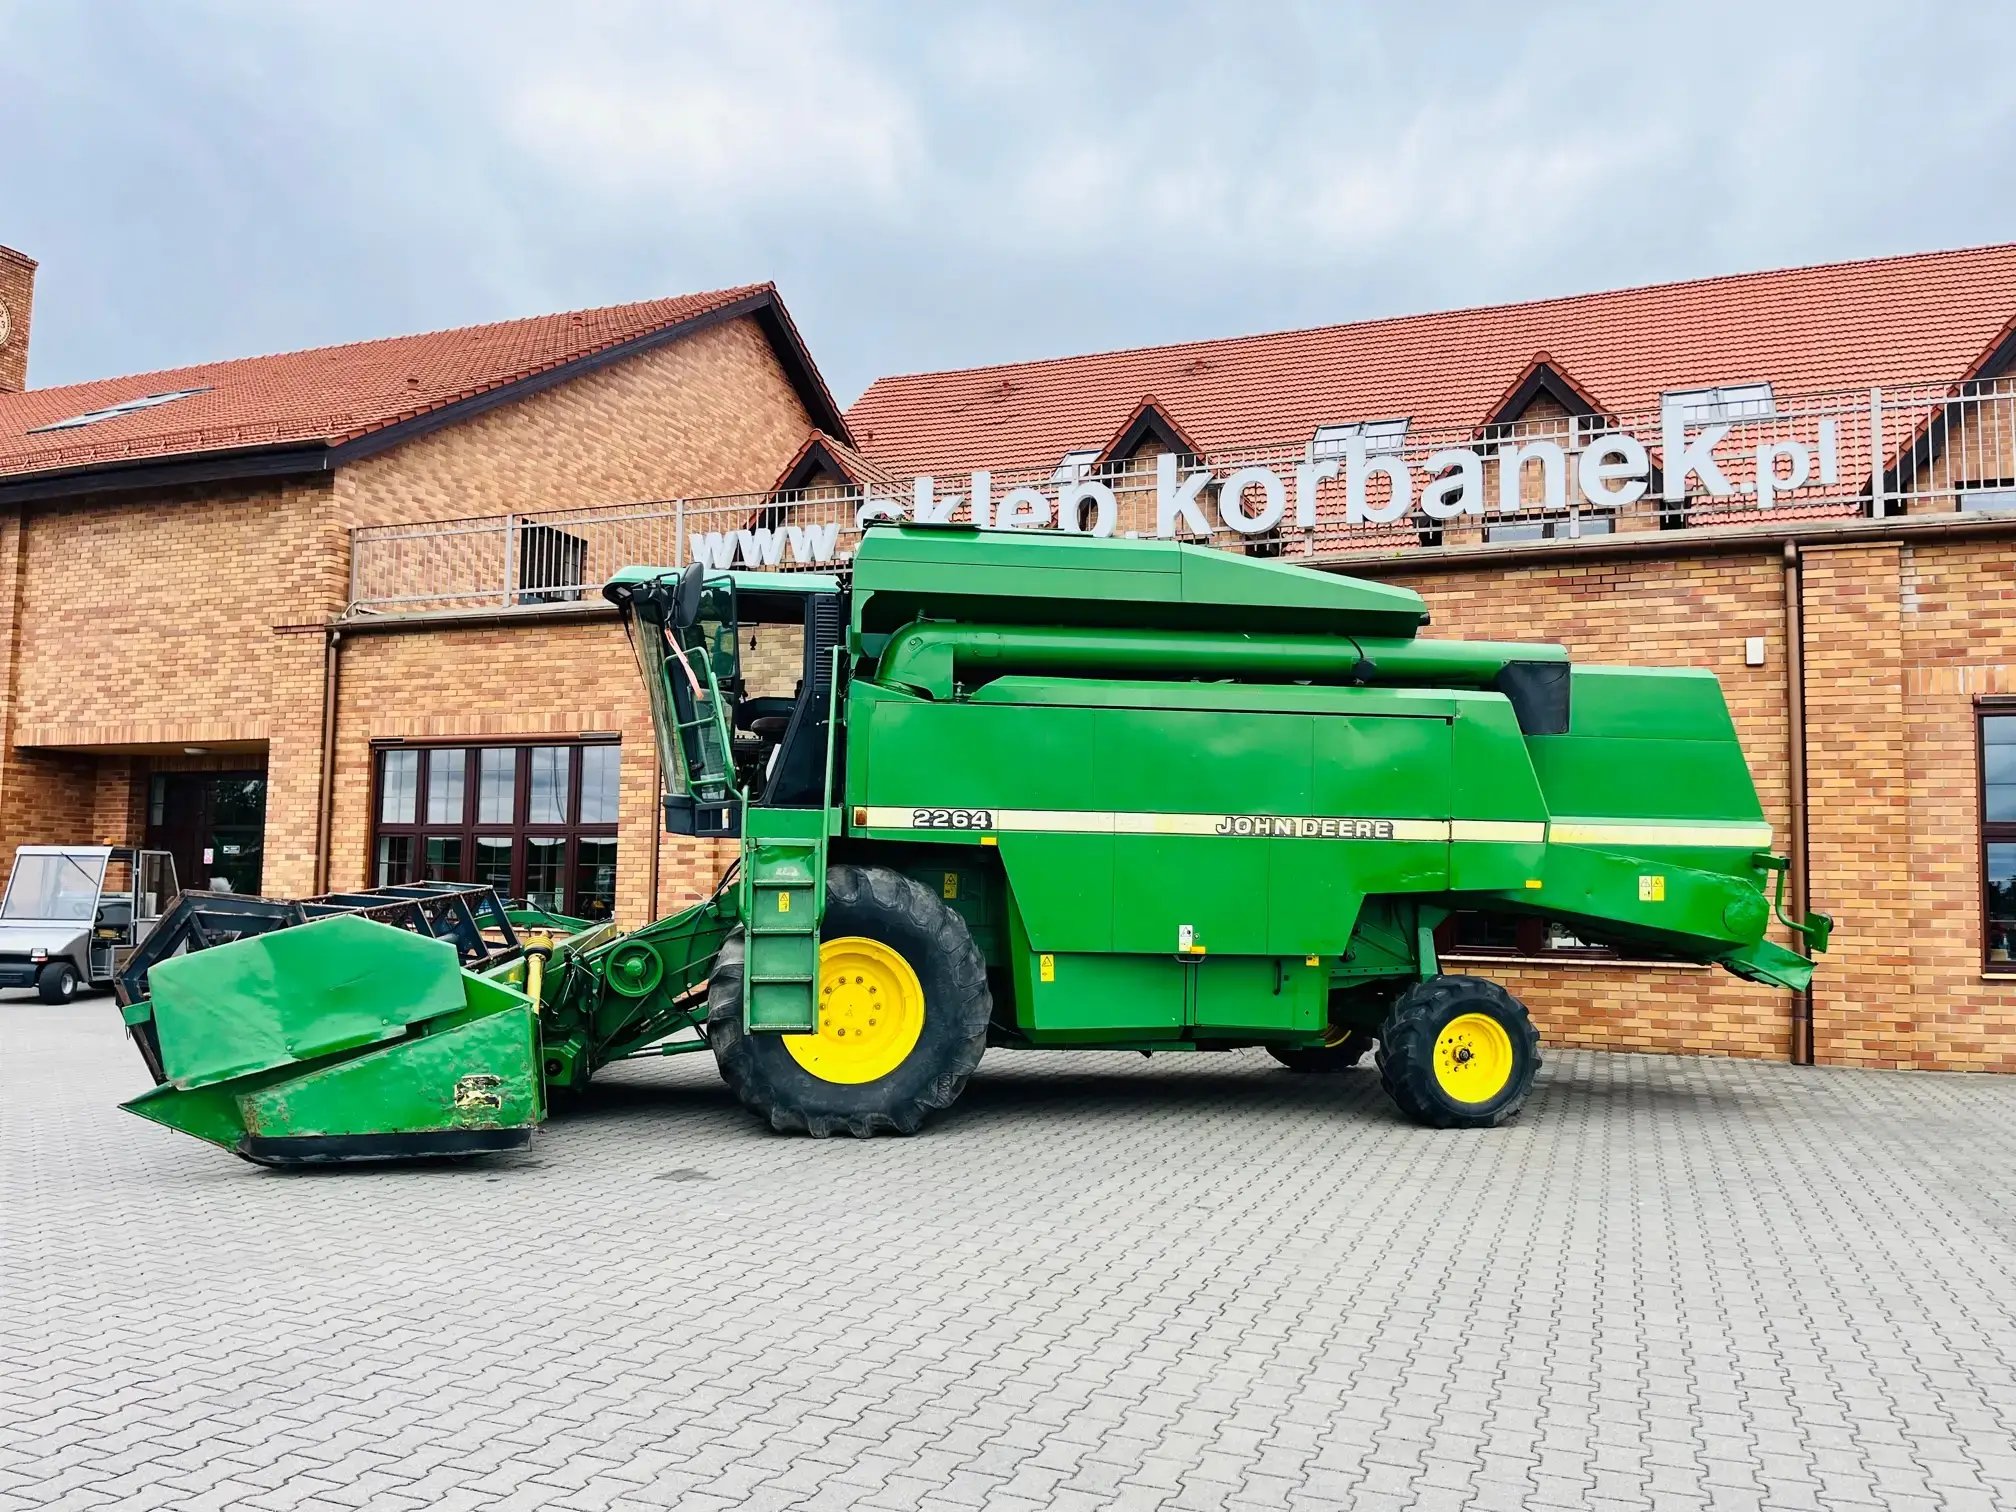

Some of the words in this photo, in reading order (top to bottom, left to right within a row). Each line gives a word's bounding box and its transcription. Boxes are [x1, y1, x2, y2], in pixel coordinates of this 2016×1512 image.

[913, 809, 992, 829] 2264
[1216, 817, 1296, 837] JOHN
[1302, 819, 1393, 839] DEERE
